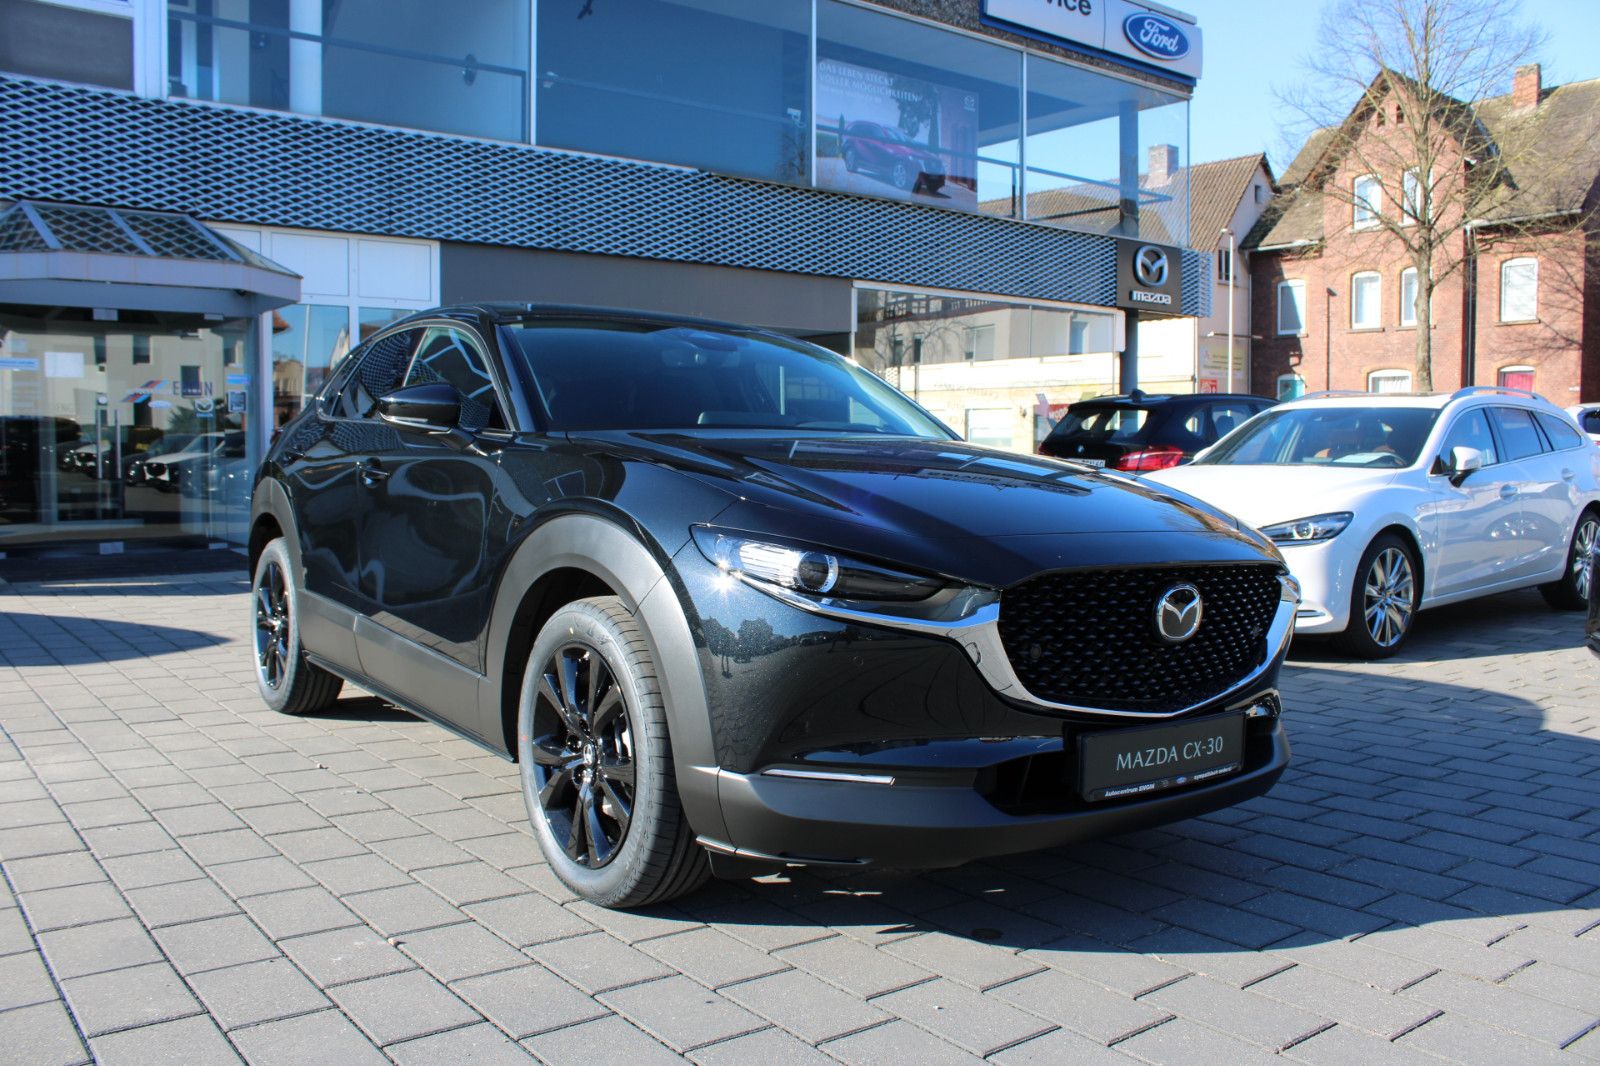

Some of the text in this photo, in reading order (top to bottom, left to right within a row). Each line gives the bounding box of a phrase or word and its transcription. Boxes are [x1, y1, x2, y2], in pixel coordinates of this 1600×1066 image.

[1047, 0, 1091, 15] ce
[1139, 18, 1179, 52] Ford
[819, 62, 894, 86] DAS LEBEN STECKT
[1132, 290, 1172, 305] mazda
[1116, 736, 1224, 771] MAZDA CX-30
